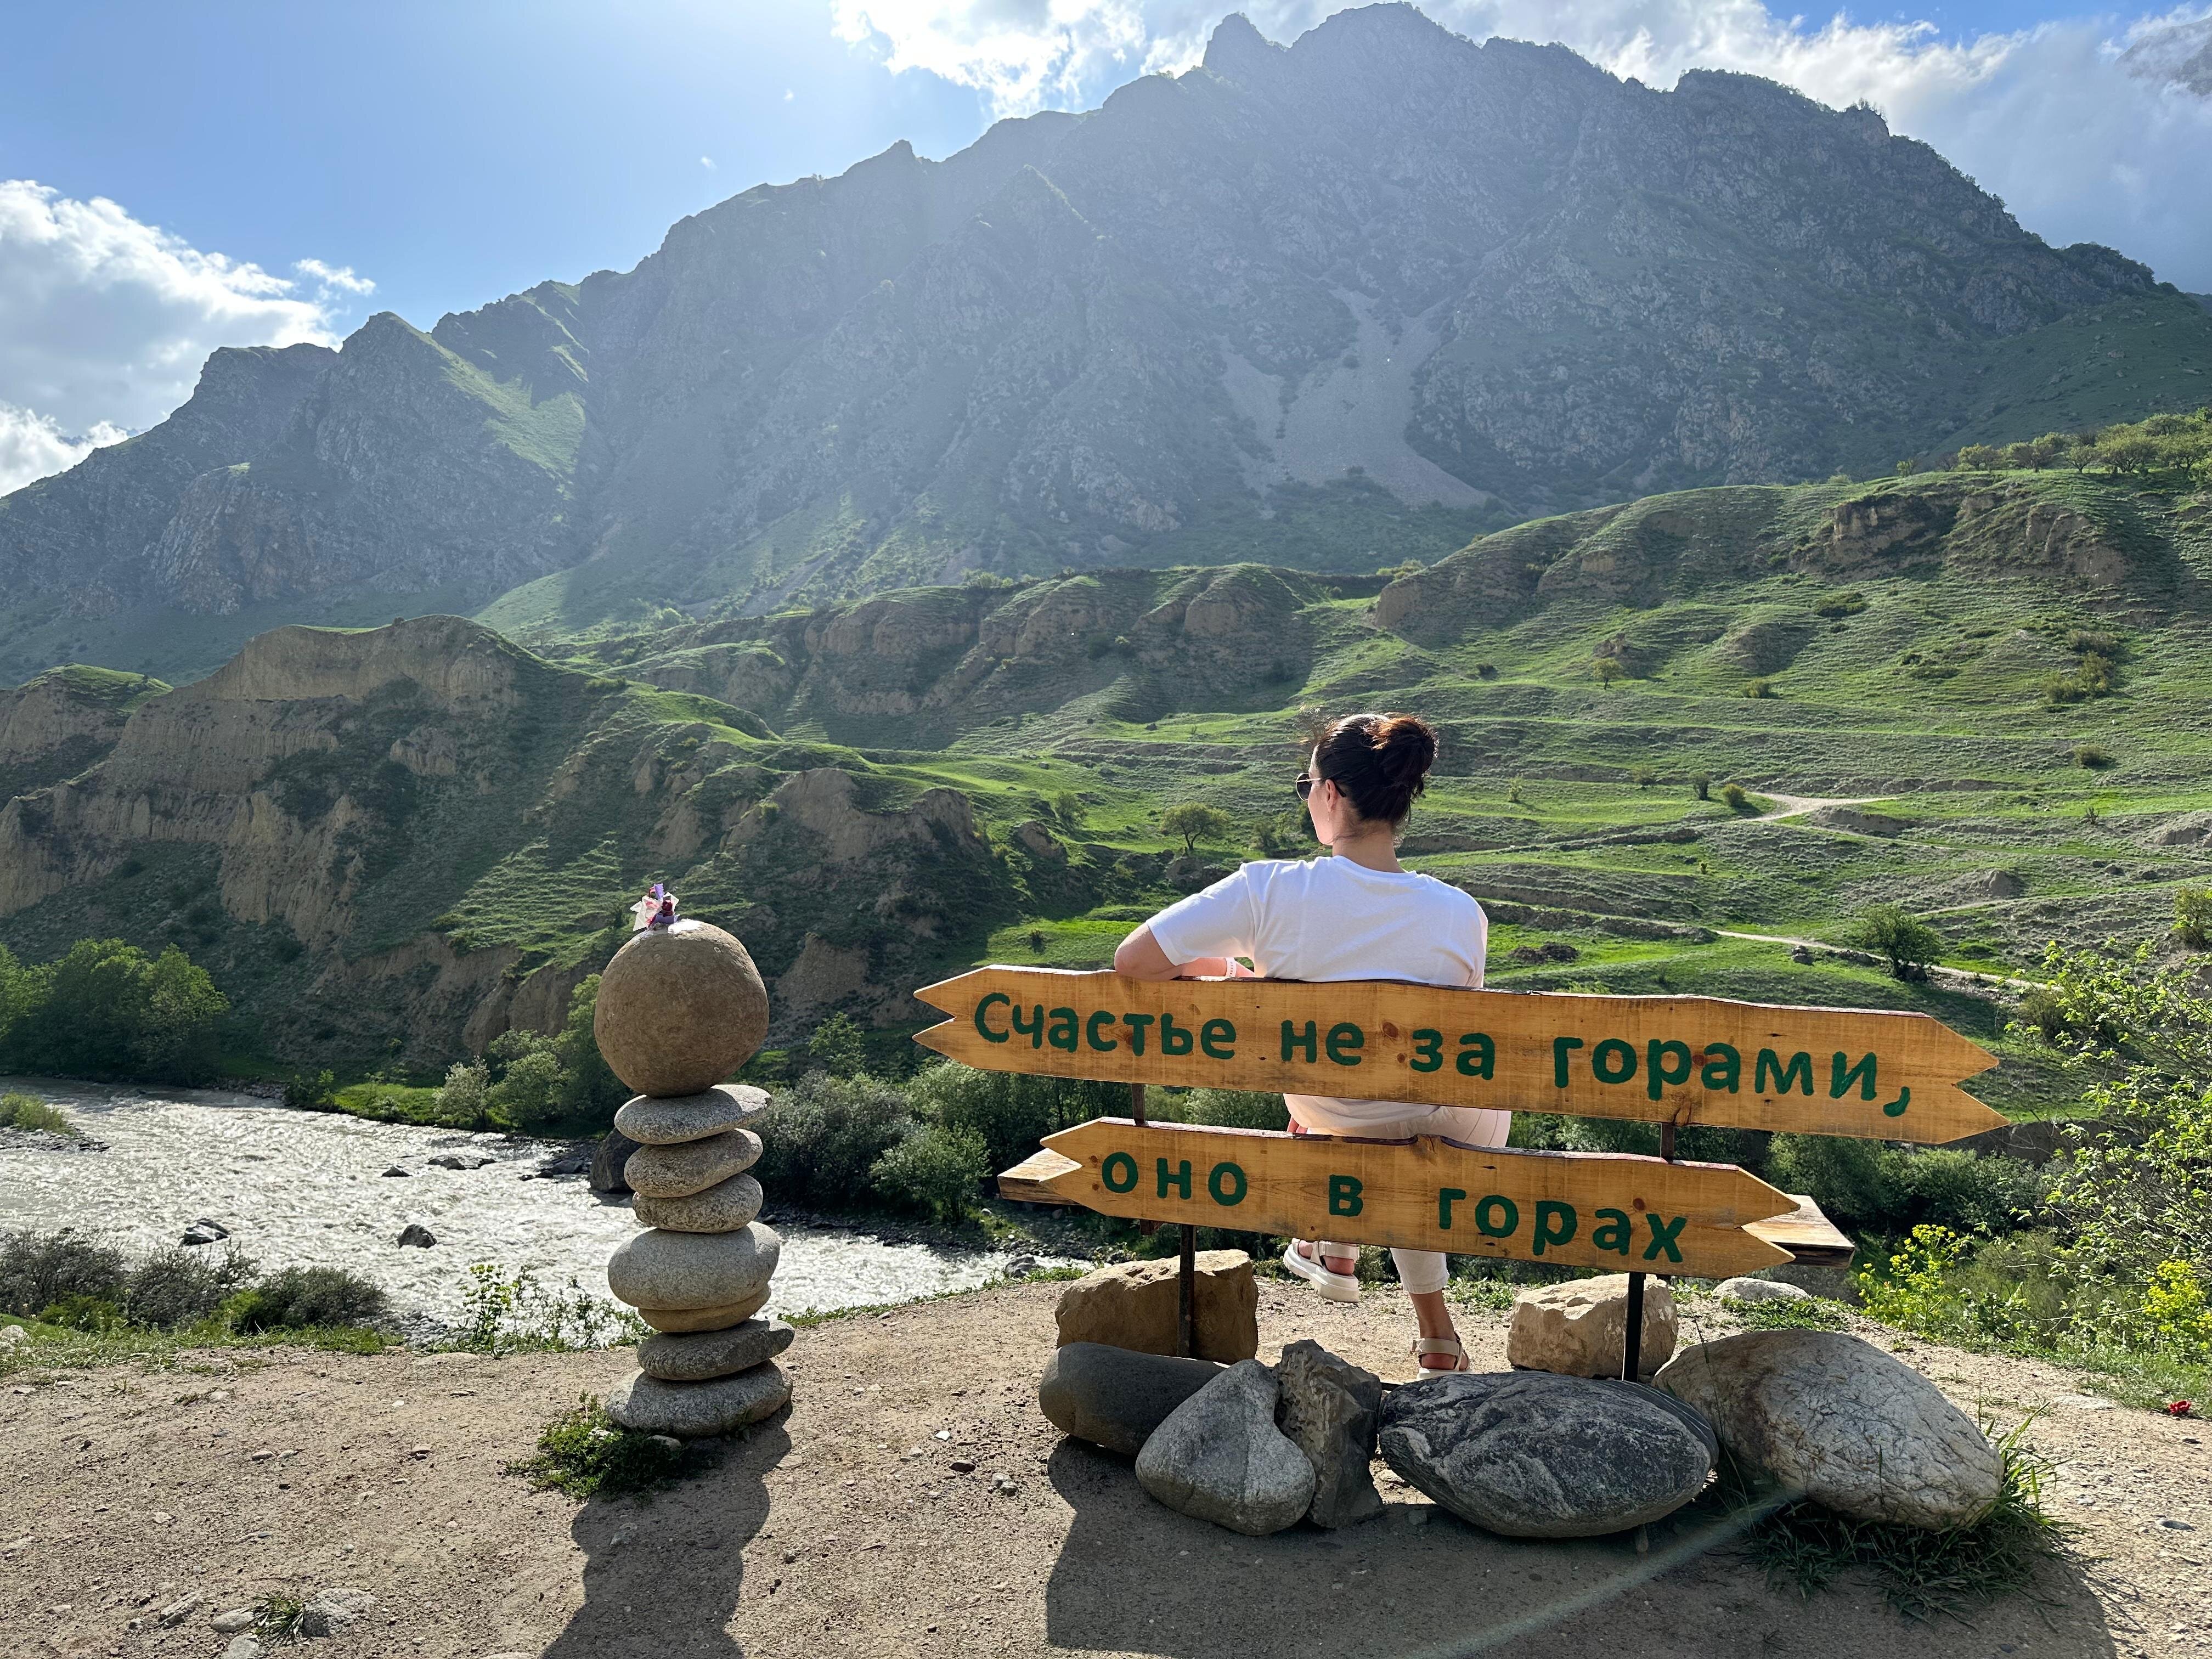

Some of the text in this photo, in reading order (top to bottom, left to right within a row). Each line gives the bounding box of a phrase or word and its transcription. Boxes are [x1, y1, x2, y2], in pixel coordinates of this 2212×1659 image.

[974, 992, 1911, 1118] Счастье не за горами,
[1101, 1151, 1687, 1263] оно в горах
